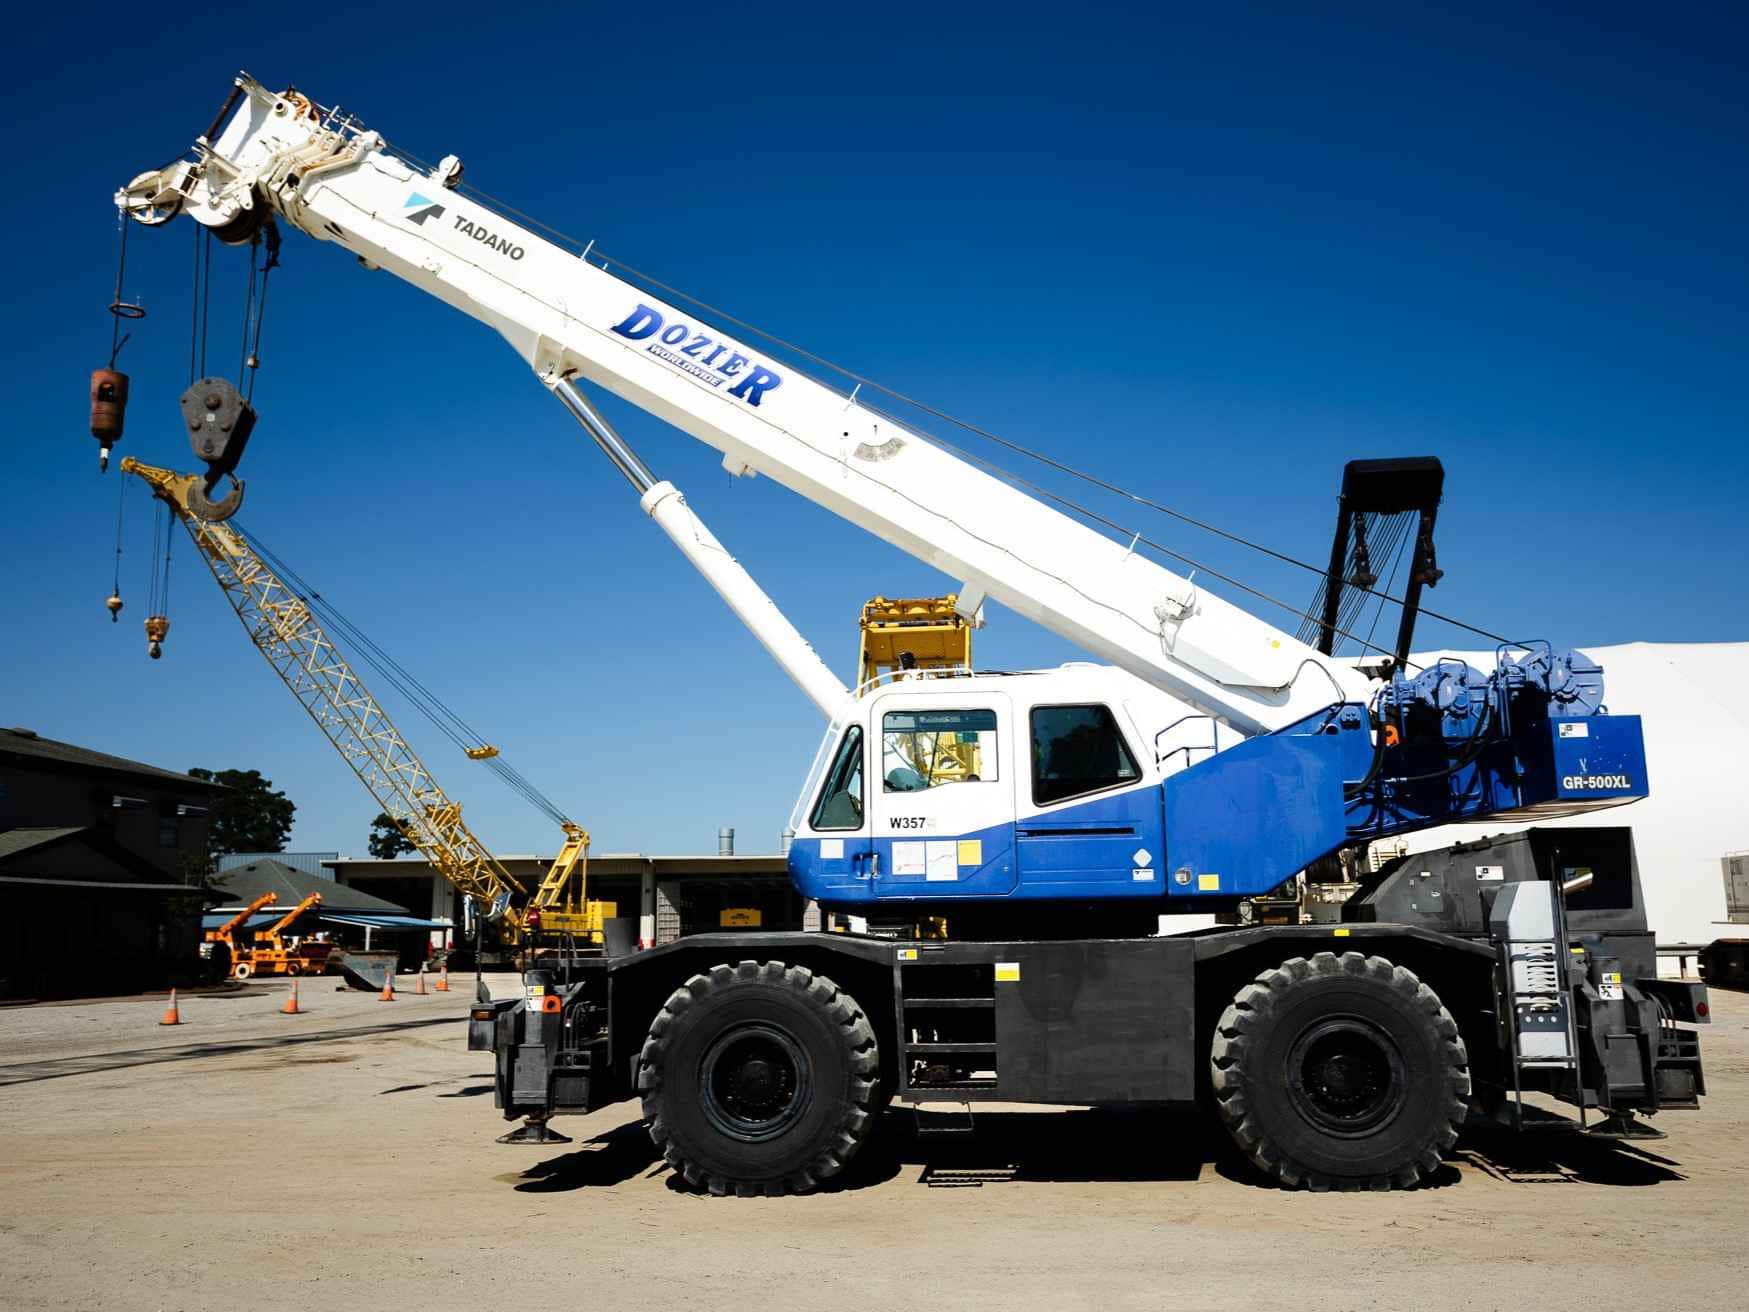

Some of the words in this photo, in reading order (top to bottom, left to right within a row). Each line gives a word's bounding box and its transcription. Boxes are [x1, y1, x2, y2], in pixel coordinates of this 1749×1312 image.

[453, 214, 525, 261] TADANO
[610, 303, 781, 407] DOZIER
[650, 344, 722, 387] WORLDWIDE
[1562, 776, 1631, 789] GR-500XL
